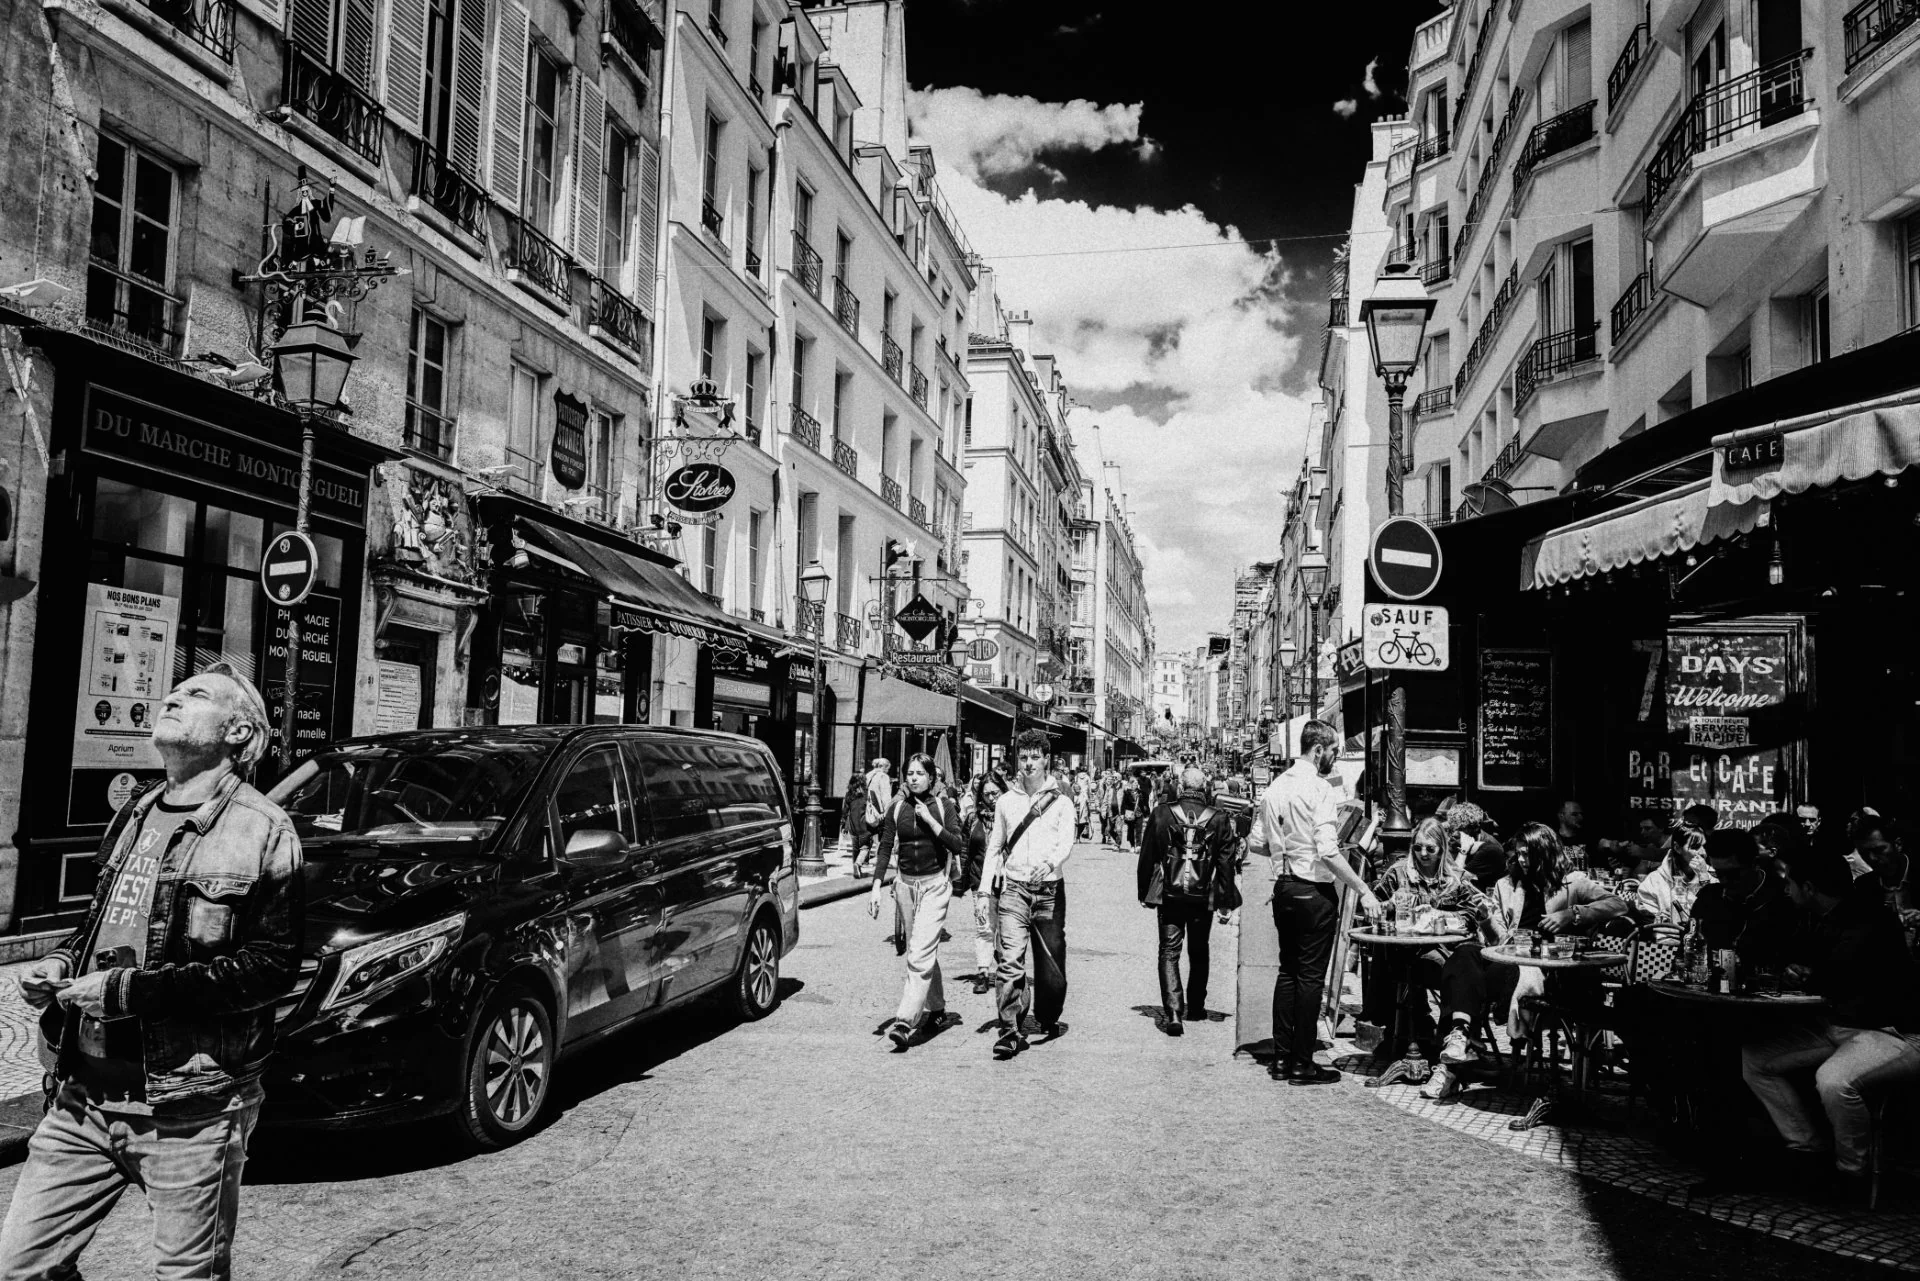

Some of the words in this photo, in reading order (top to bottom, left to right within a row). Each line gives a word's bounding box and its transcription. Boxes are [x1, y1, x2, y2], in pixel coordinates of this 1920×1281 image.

[95, 409, 132, 437] DU
[139, 422, 231, 469] MARCHE
[235, 453, 363, 509] MONTOGUEIL
[1729, 440, 1777, 465] CAFE
[667, 470, 732, 501] Stohrer
[107, 590, 121, 602] NOS
[122, 593, 140, 605] BONS
[140, 597, 161, 608] PLANS
[617, 611, 653, 629] PATISSIER
[669, 620, 708, 641] STOHRER
[1381, 608, 1433, 626] SAUF
[892, 652, 941, 665] Restaurant
[973, 667, 990, 677] BAR
[1632, 640, 1663, 722] 7
[1681, 655, 1774, 674] DAYS
[1673, 685, 1770, 708] Welcome
[1694, 724, 1746, 733] SERVICE
[1694, 732, 1746, 743] RAPIDE
[107, 744, 134, 756] Aprium
[1629, 750, 1671, 790] BAR
[1718, 754, 1775, 795] CAFE
